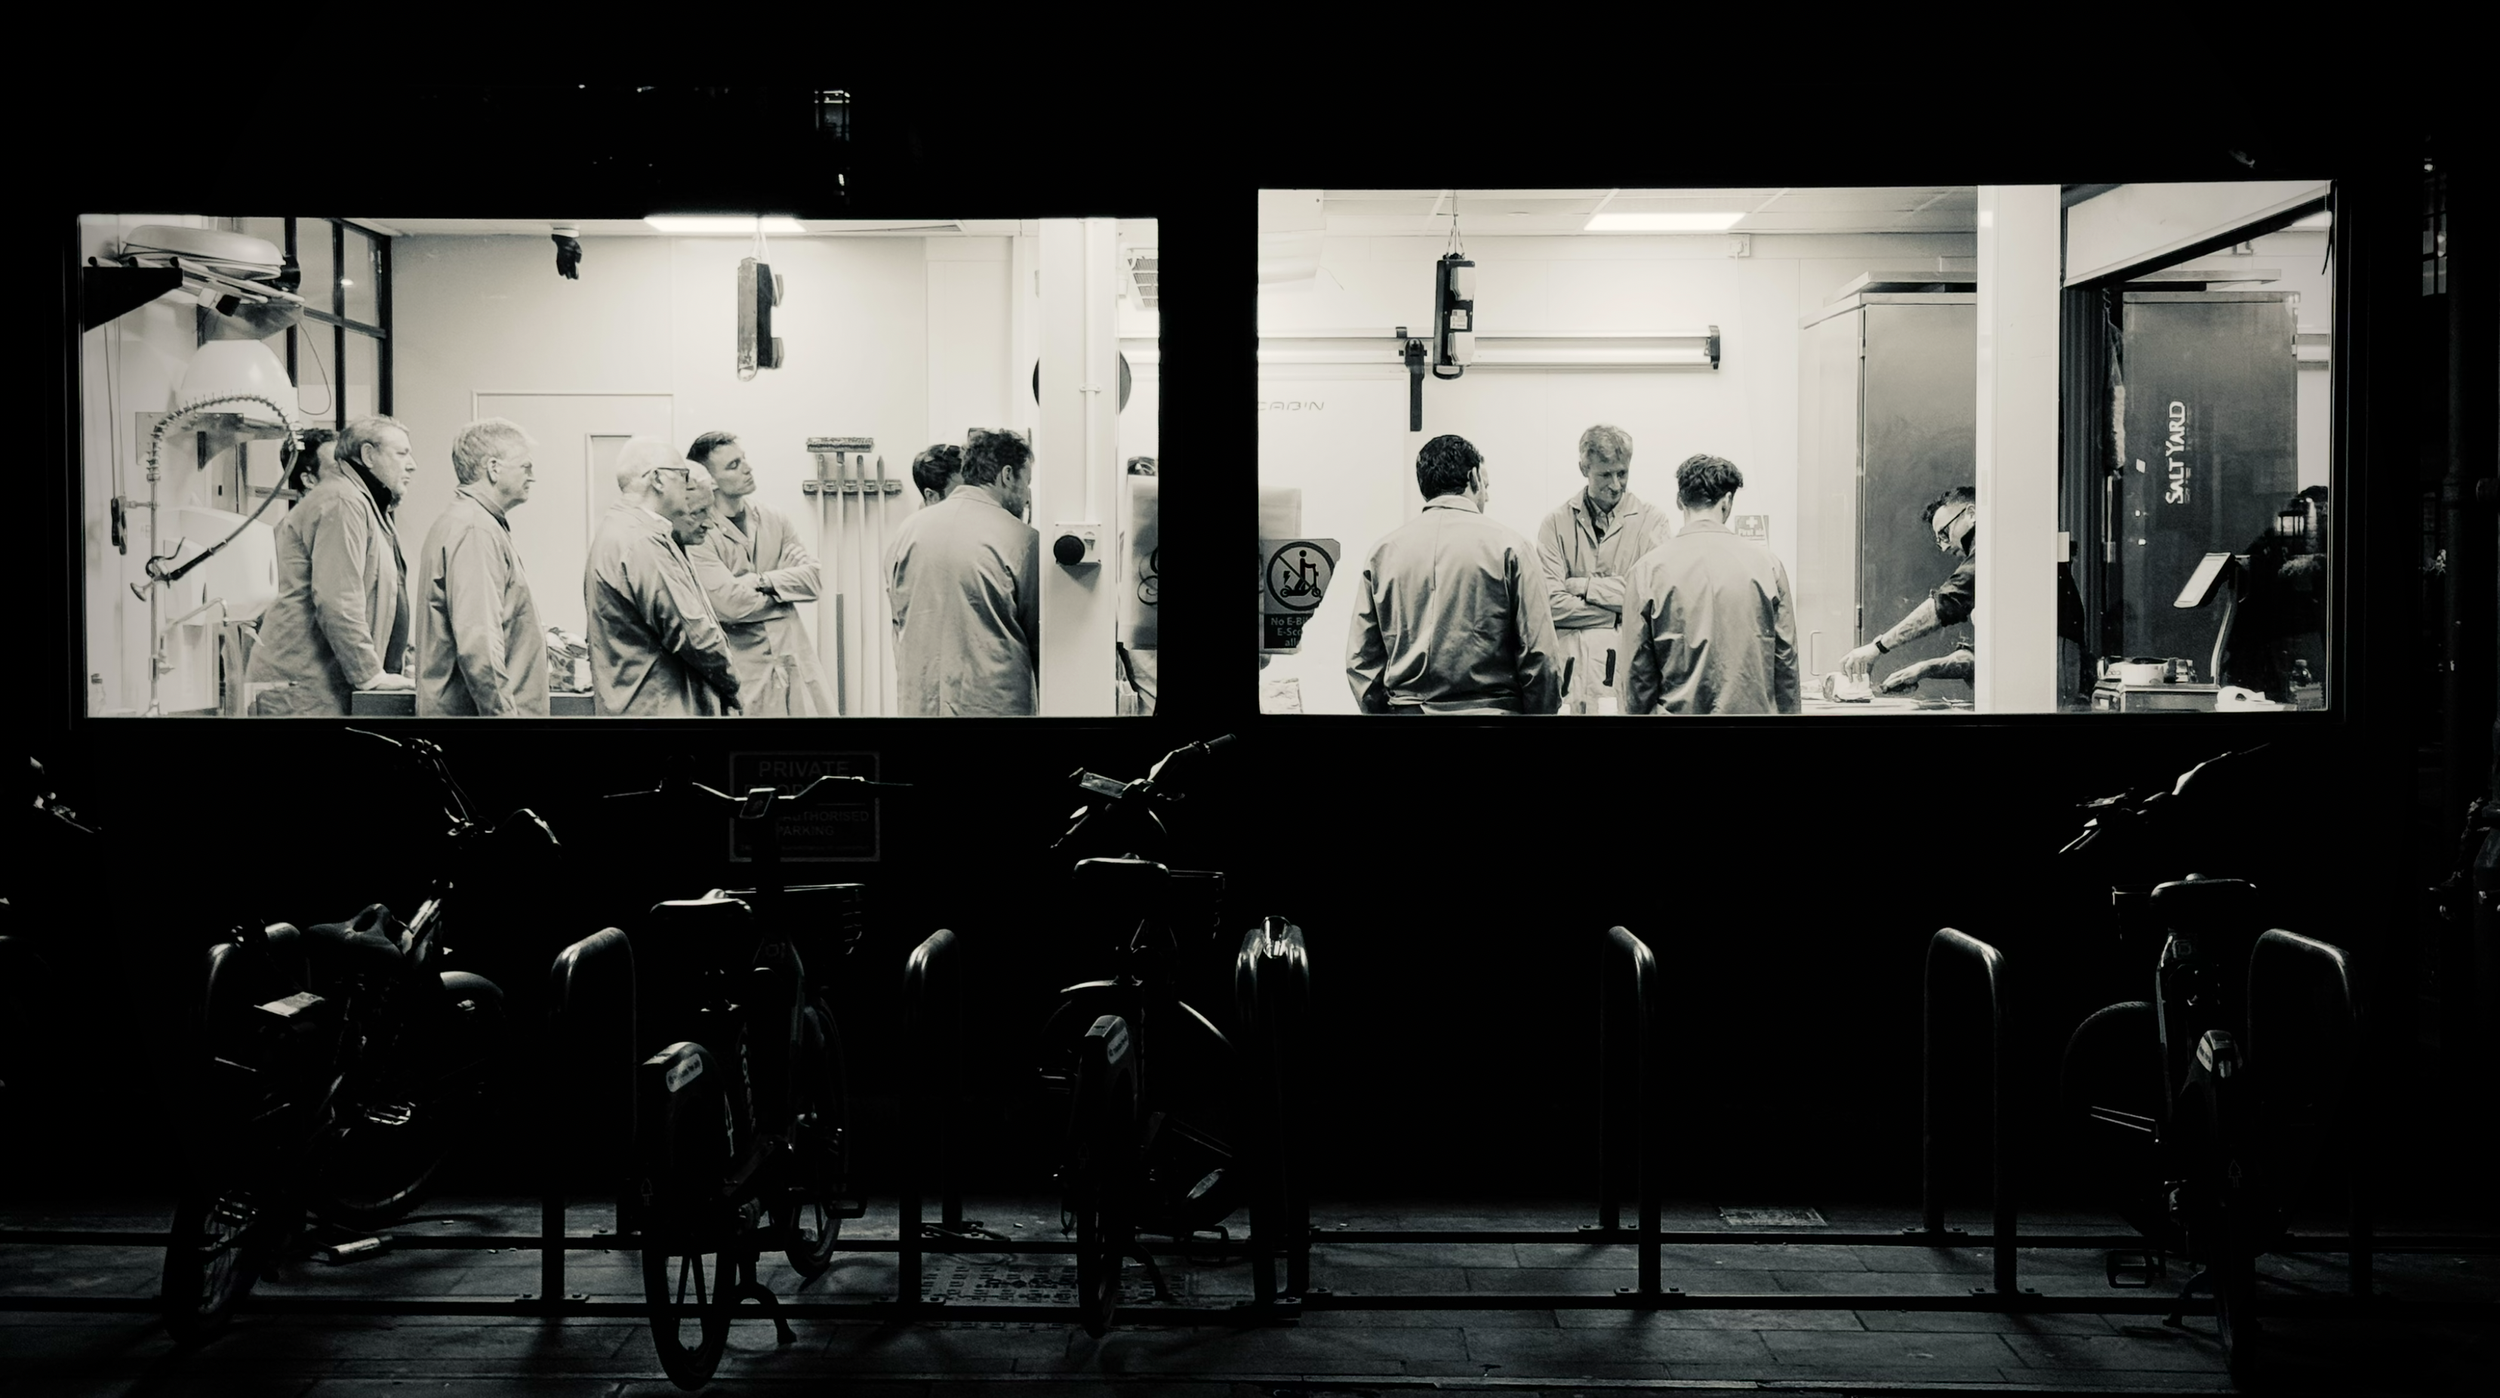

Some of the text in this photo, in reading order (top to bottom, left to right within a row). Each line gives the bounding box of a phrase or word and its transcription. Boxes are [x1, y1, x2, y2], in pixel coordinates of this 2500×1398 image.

[2165, 401, 2186, 504] SALT YARD
[1271, 617, 1285, 626] No
[1285, 637, 1298, 647] all
[758, 760, 850, 777] PRIVATE
